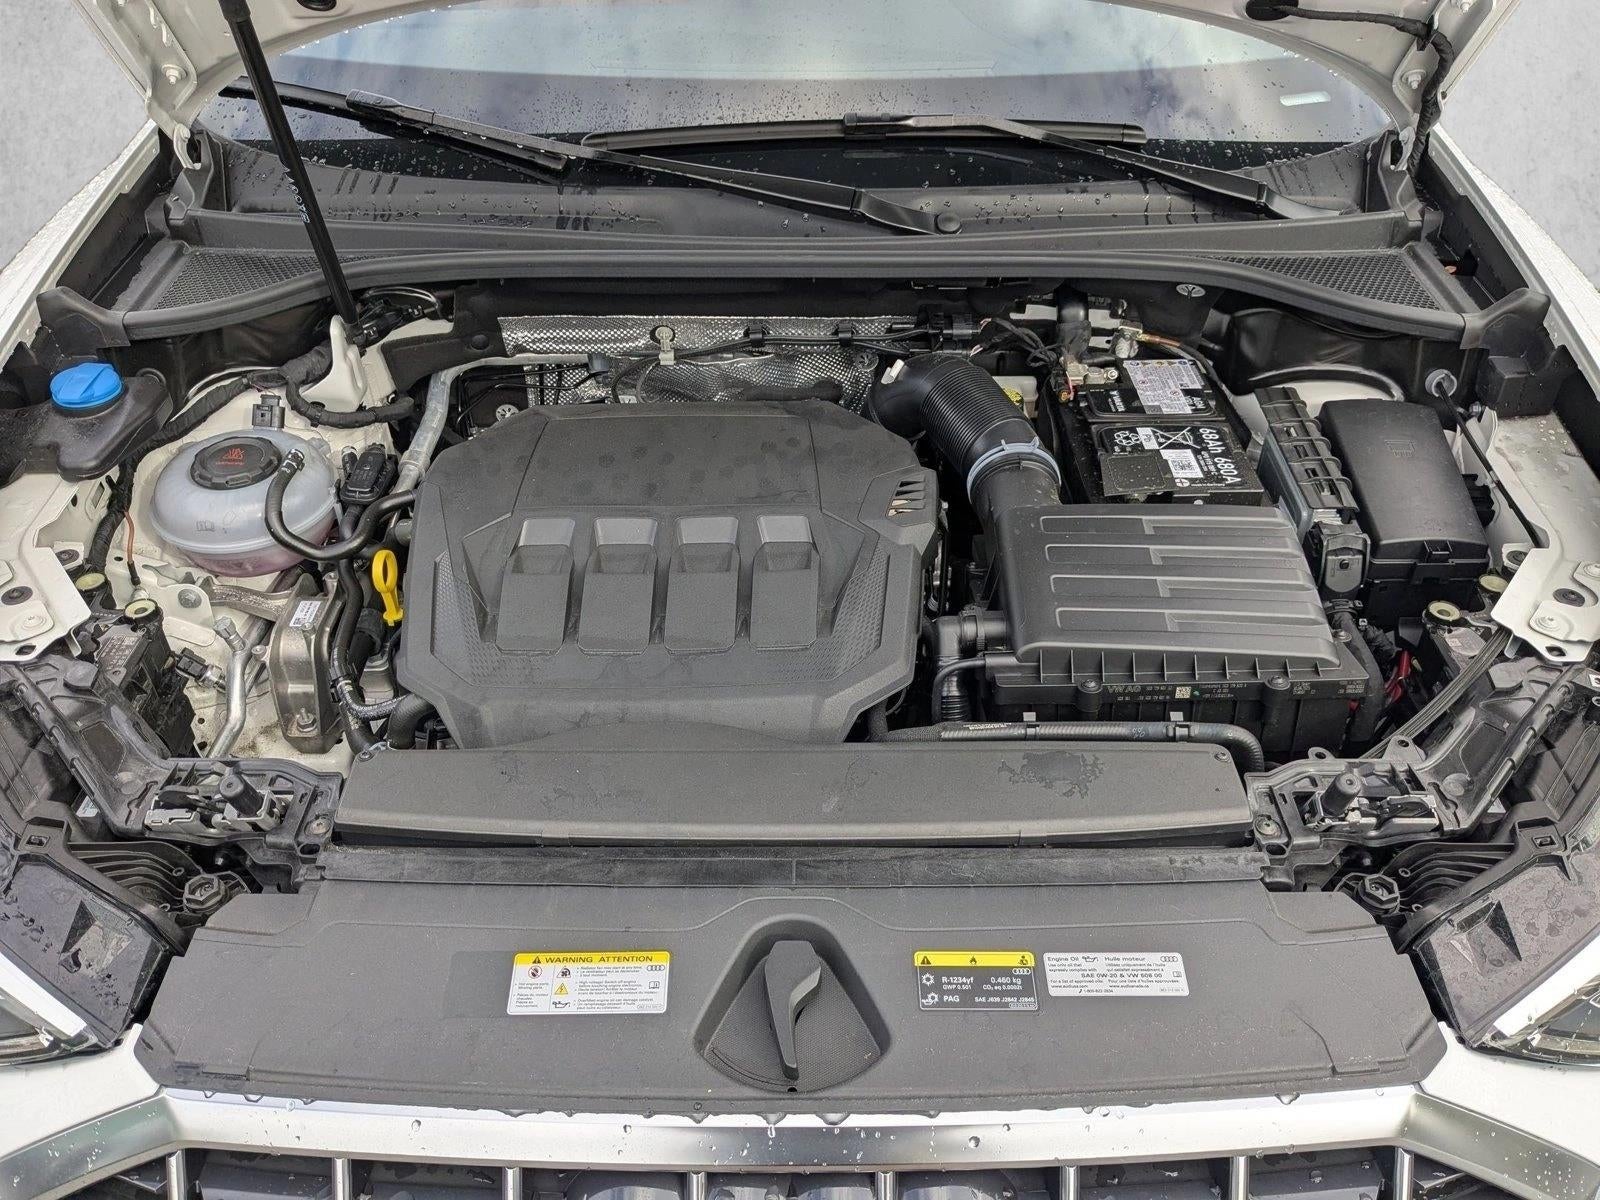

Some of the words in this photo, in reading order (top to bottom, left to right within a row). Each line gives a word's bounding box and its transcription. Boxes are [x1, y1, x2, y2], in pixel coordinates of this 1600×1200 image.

[1112, 395, 1125, 412] VARTA
[1199, 428, 1226, 454] 68Ah
[1214, 457, 1242, 484] 680A
